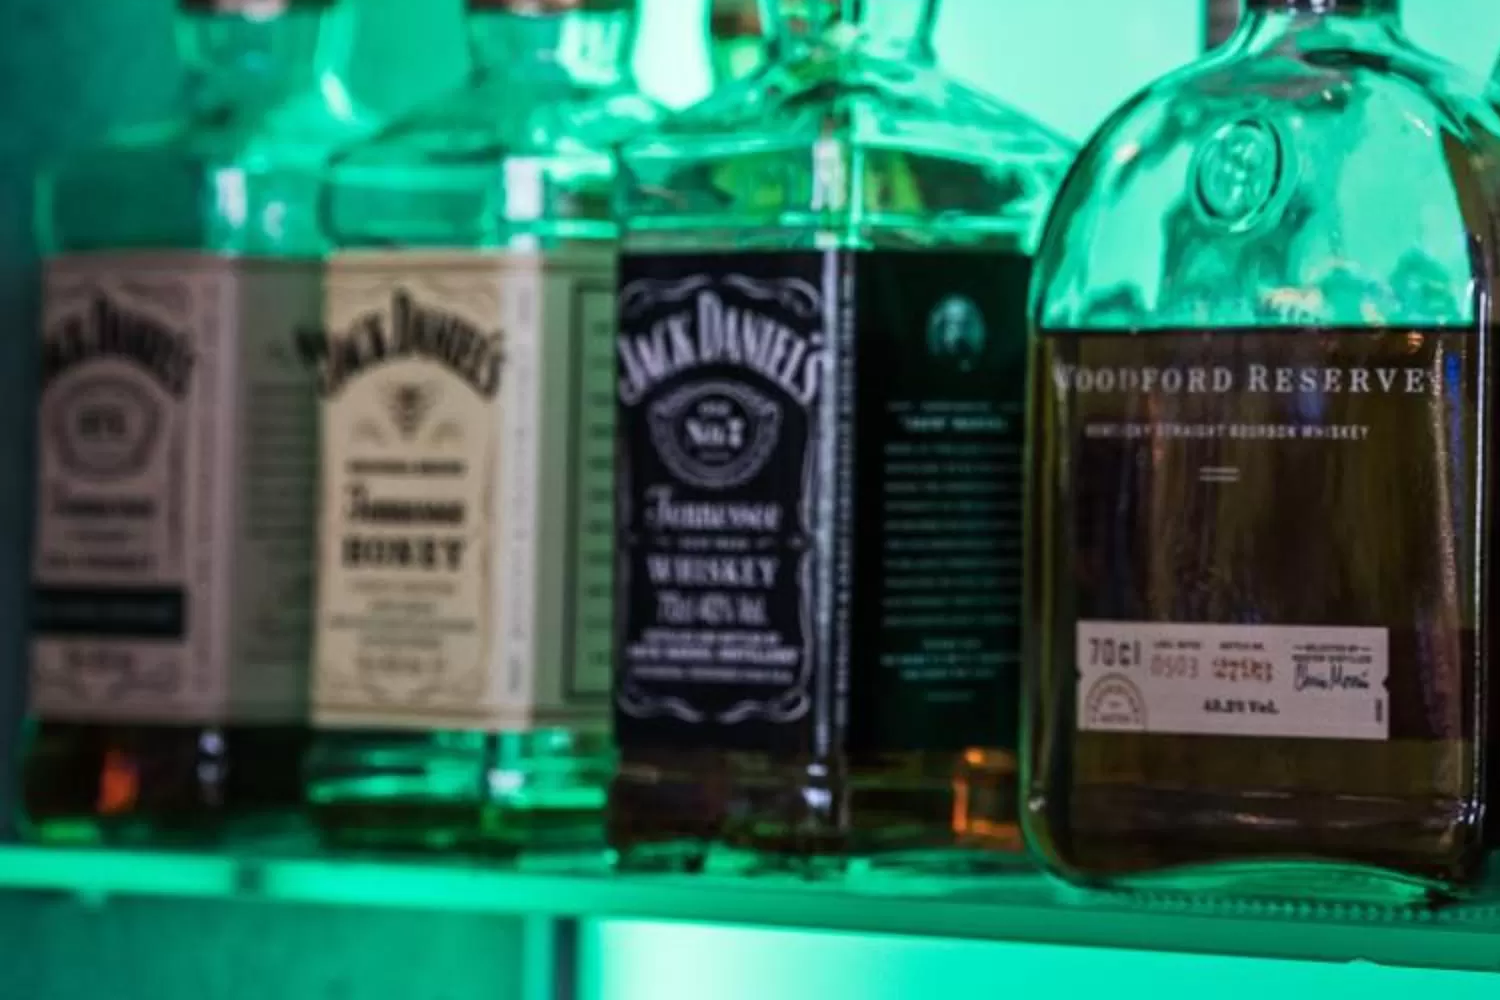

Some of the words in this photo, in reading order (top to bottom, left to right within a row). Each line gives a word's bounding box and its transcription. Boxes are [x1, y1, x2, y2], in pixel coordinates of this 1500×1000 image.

[617, 312, 697, 406] JACK
[697, 289, 832, 405] DANIEL'S
[1247, 361, 1428, 394] RESERVE
[647, 554, 779, 589] WHISKEY
